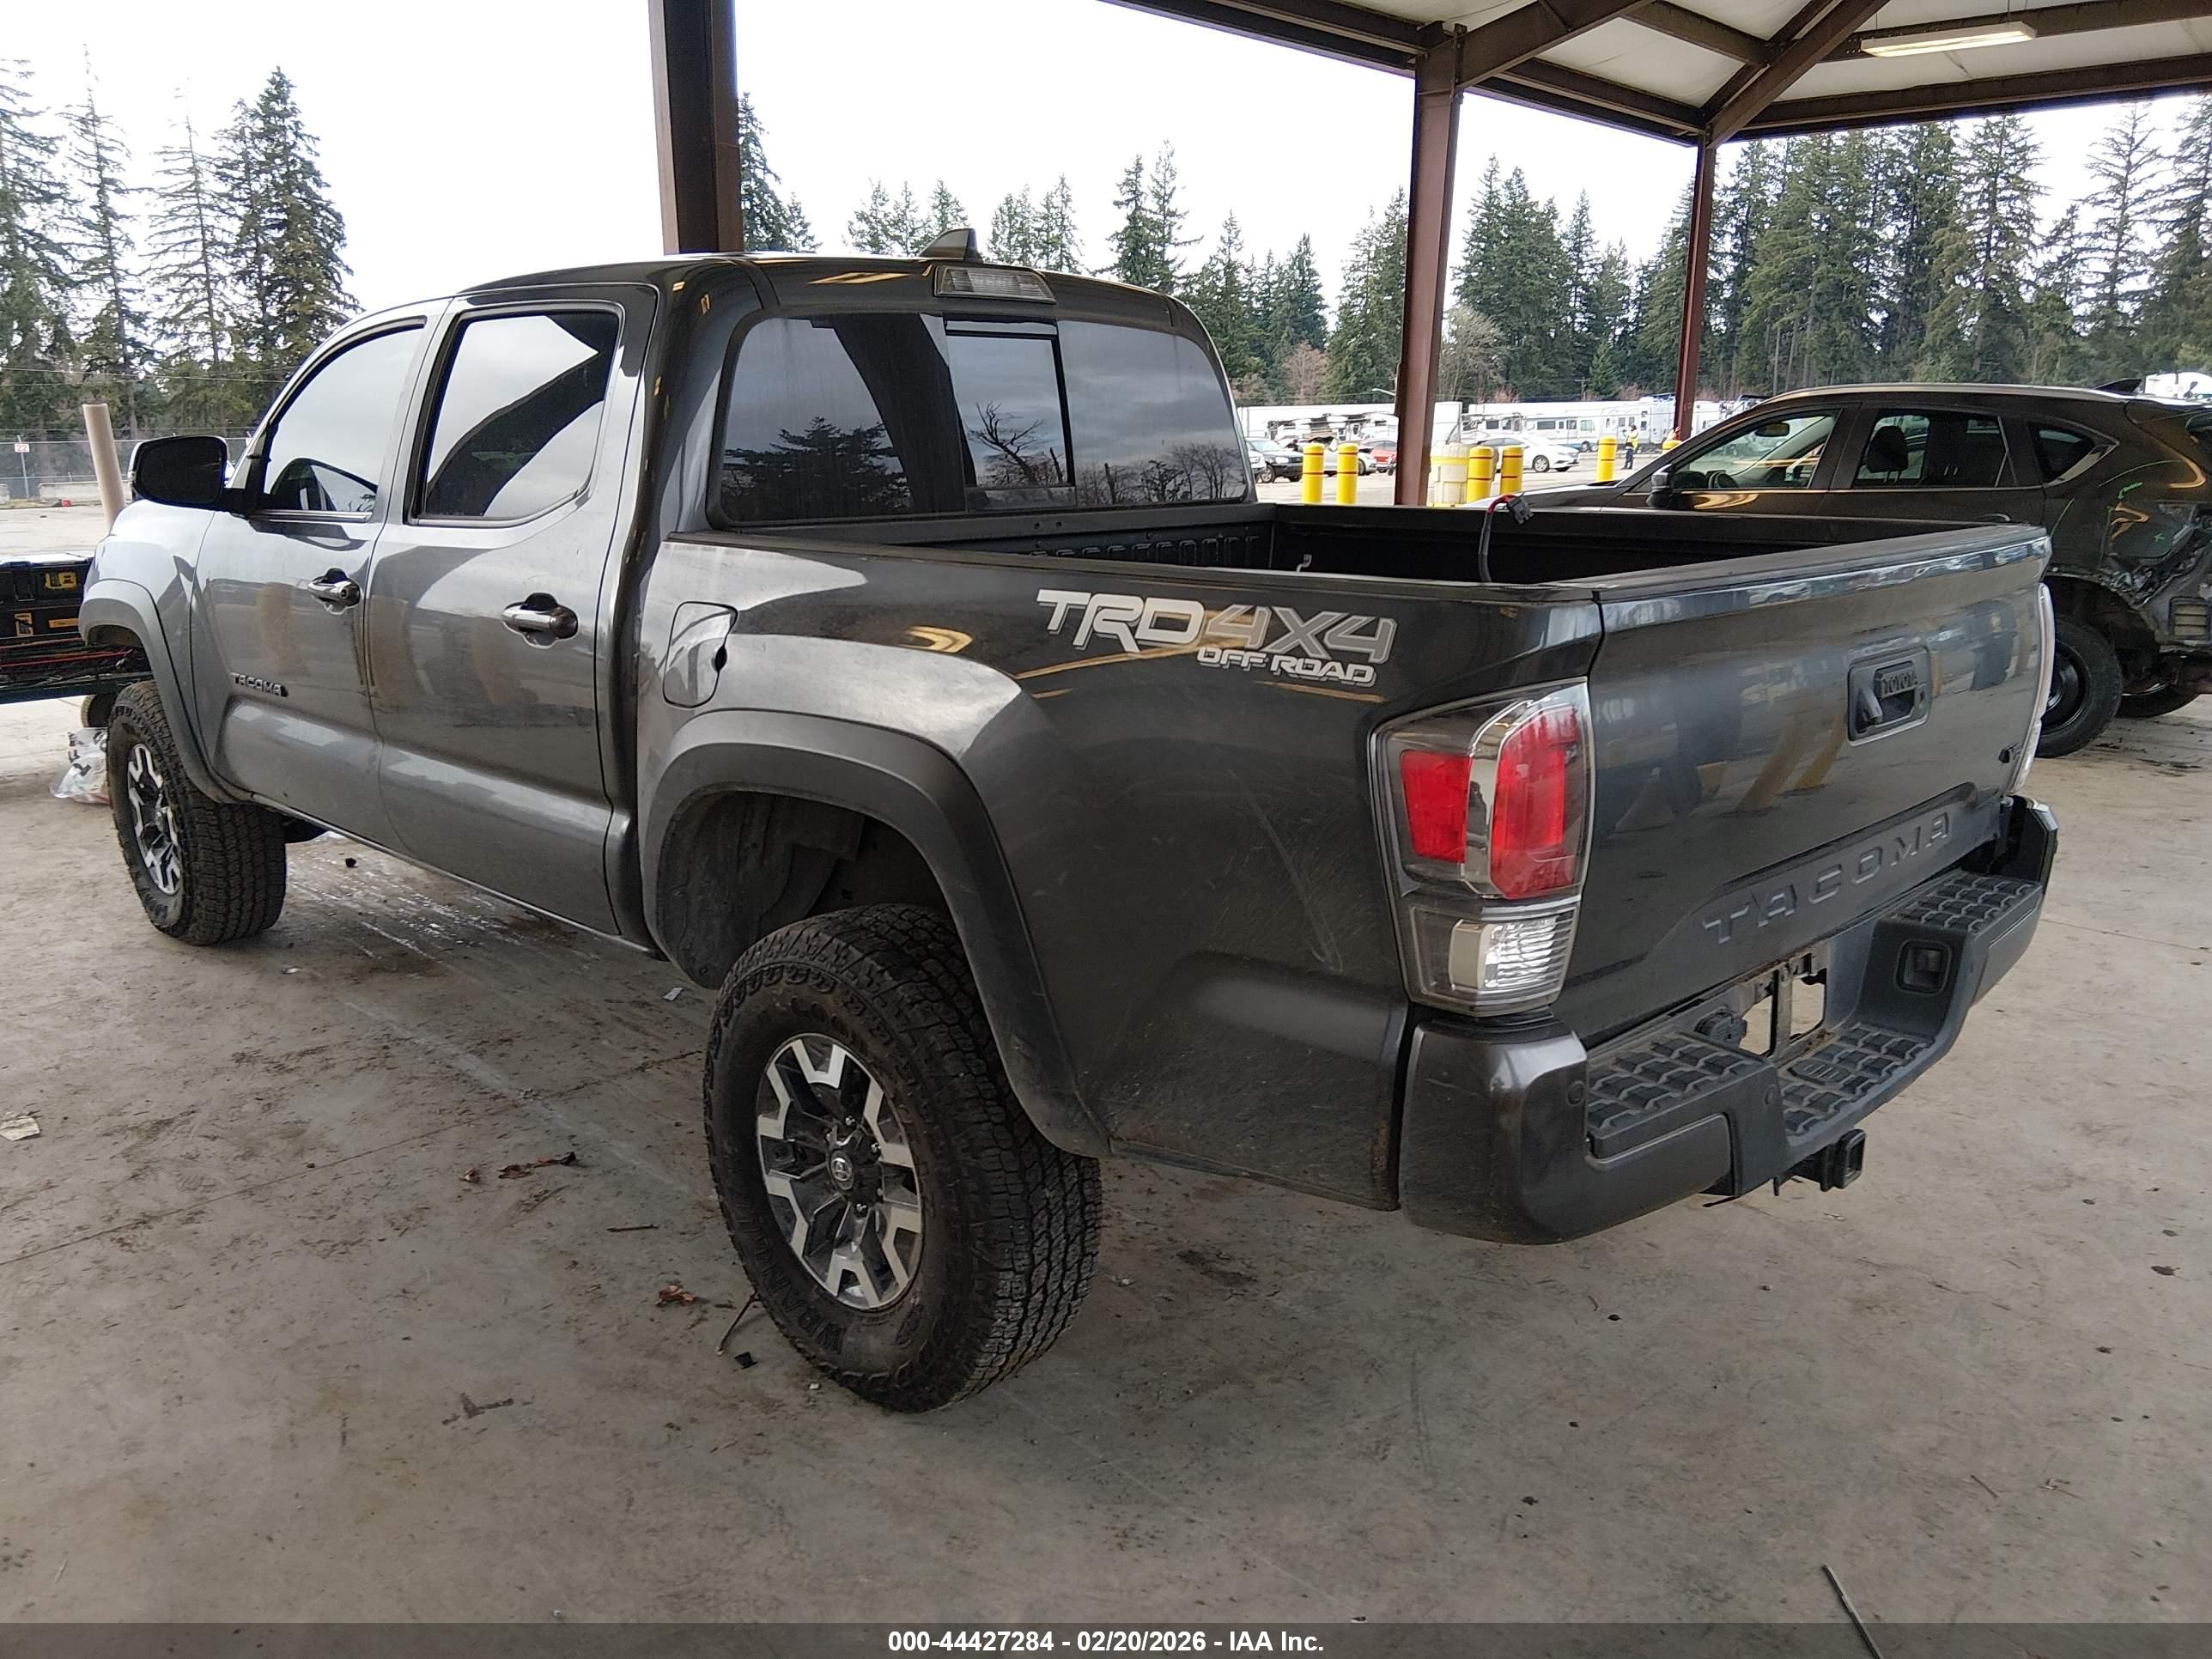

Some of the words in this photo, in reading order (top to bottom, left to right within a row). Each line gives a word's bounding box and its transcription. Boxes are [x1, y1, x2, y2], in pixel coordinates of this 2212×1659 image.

[1036, 588, 1206, 653] TRD
[1204, 604, 1398, 665] 4X4
[229, 672, 289, 697] TACOMA
[1196, 646, 1270, 672] OFF
[1270, 654, 1378, 688] ROAD
[1881, 669, 1918, 696] TOYOTA
[1703, 811, 1951, 944] TACOMA
